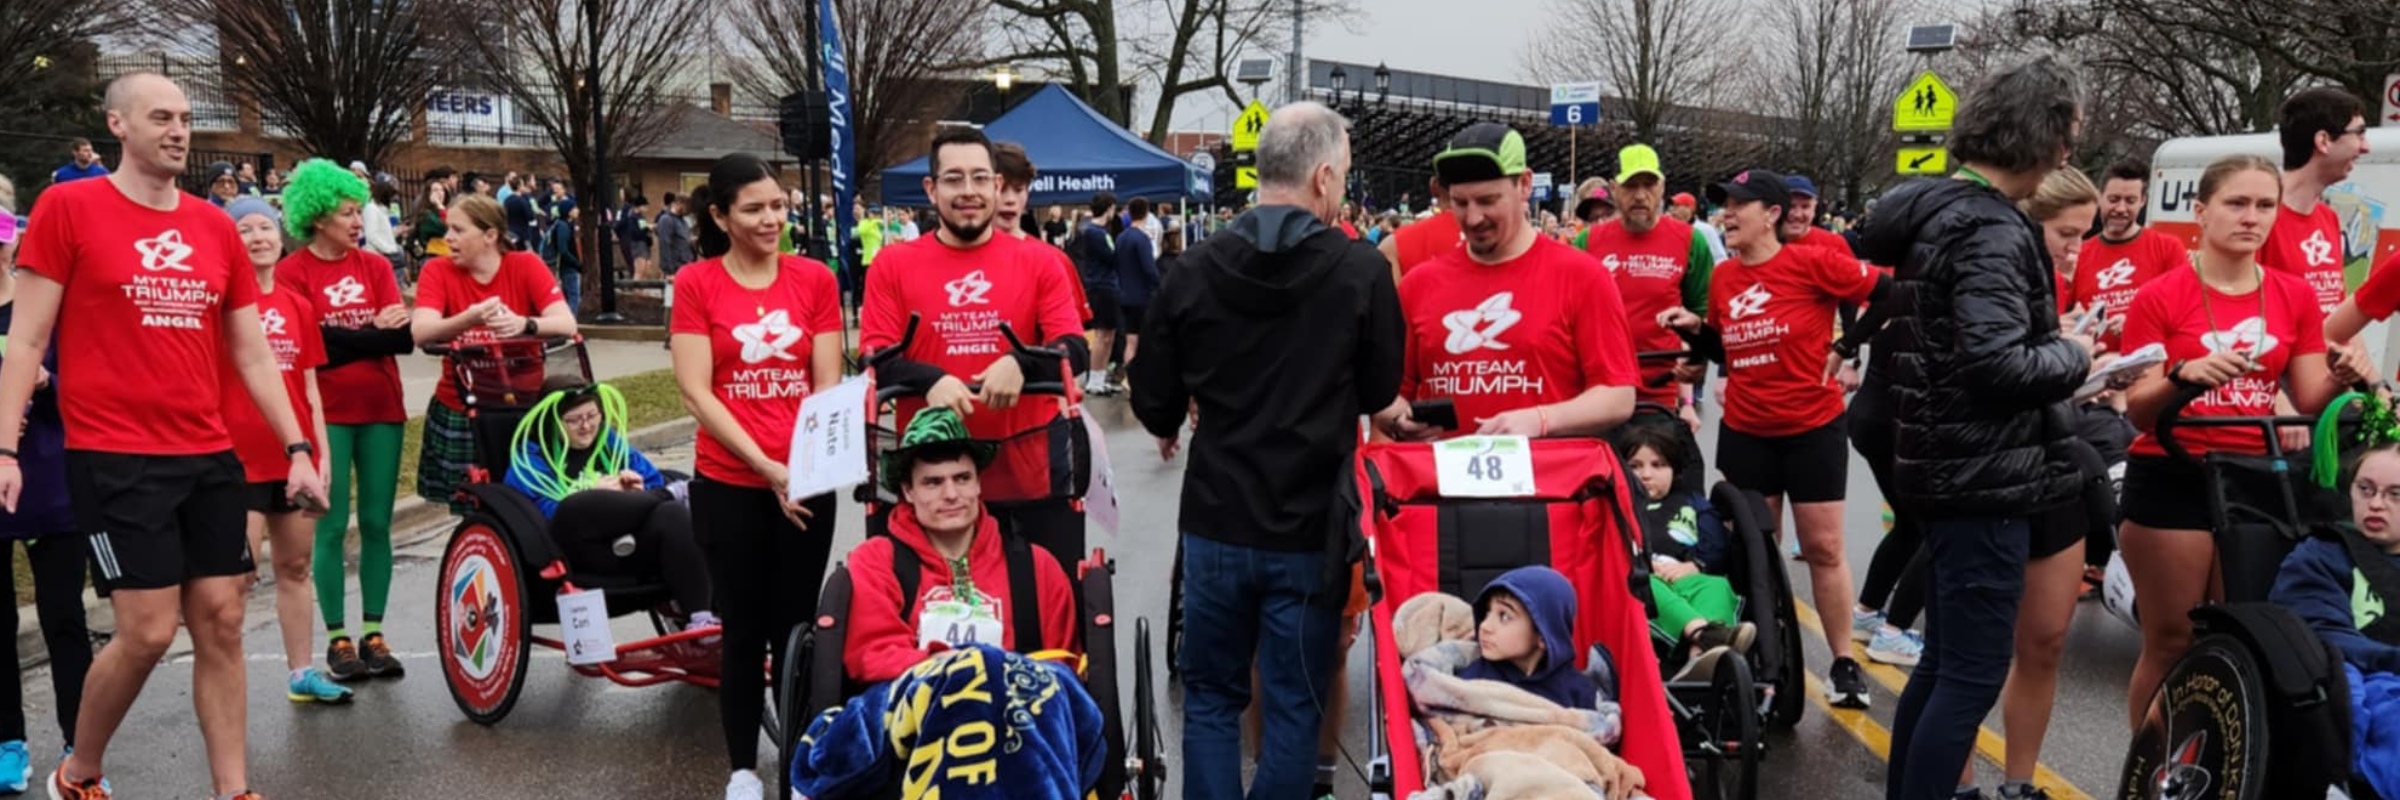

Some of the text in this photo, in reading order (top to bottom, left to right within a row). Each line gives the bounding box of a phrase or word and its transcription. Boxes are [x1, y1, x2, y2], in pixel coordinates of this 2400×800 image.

[1567, 104, 1582, 124] 6
[1058, 173, 1115, 192] Health
[120, 284, 220, 304] TRIUMPH
[141, 314, 203, 330] ANGEL
[931, 319, 1011, 333] TRIUMP
[946, 343, 1000, 356] ANGEL
[1732, 352, 1778, 368] ANGEL
[1425, 375, 1544, 395] TRIUMPH
[826, 411, 841, 456] Nate
[1466, 455, 1503, 481] 48
[946, 622, 977, 645] 44
[947, 721, 997, 786] OF
